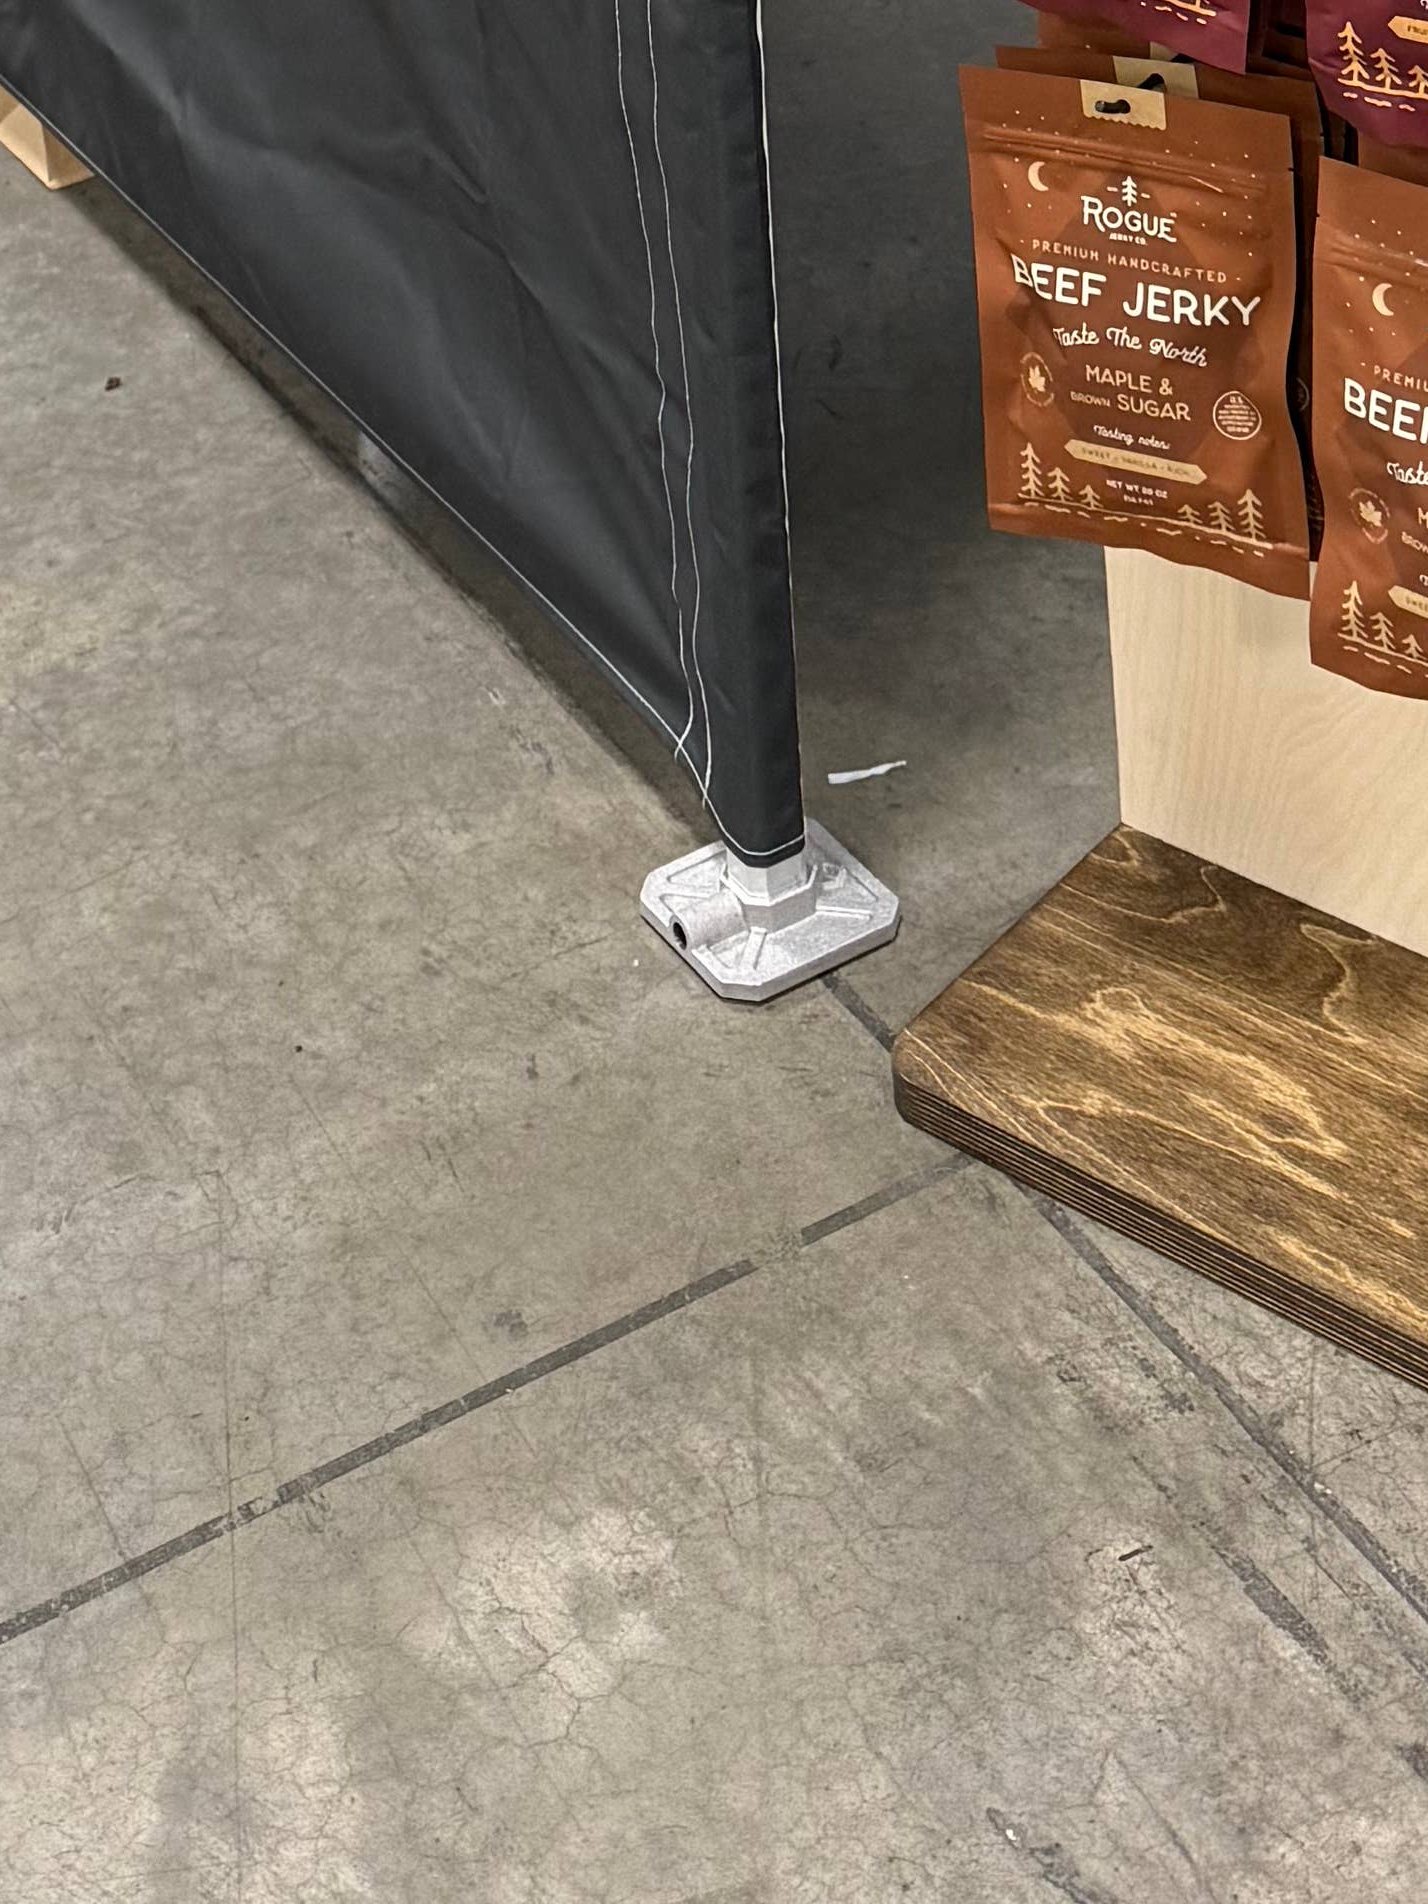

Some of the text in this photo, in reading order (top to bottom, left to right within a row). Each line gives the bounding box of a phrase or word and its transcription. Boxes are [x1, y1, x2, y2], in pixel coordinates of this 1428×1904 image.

[1080, 195, 1177, 243] ROGUE
[1031, 238, 1228, 283] PREMIUM HANDCRAFTED
[1010, 253, 1262, 327] BEEF JERKY
[1052, 322, 1209, 369] Taste The North
[1085, 364, 1173, 396] MAPLE &
[1069, 390, 1111, 408] BROWN
[1116, 393, 1192, 422] SUGAR
